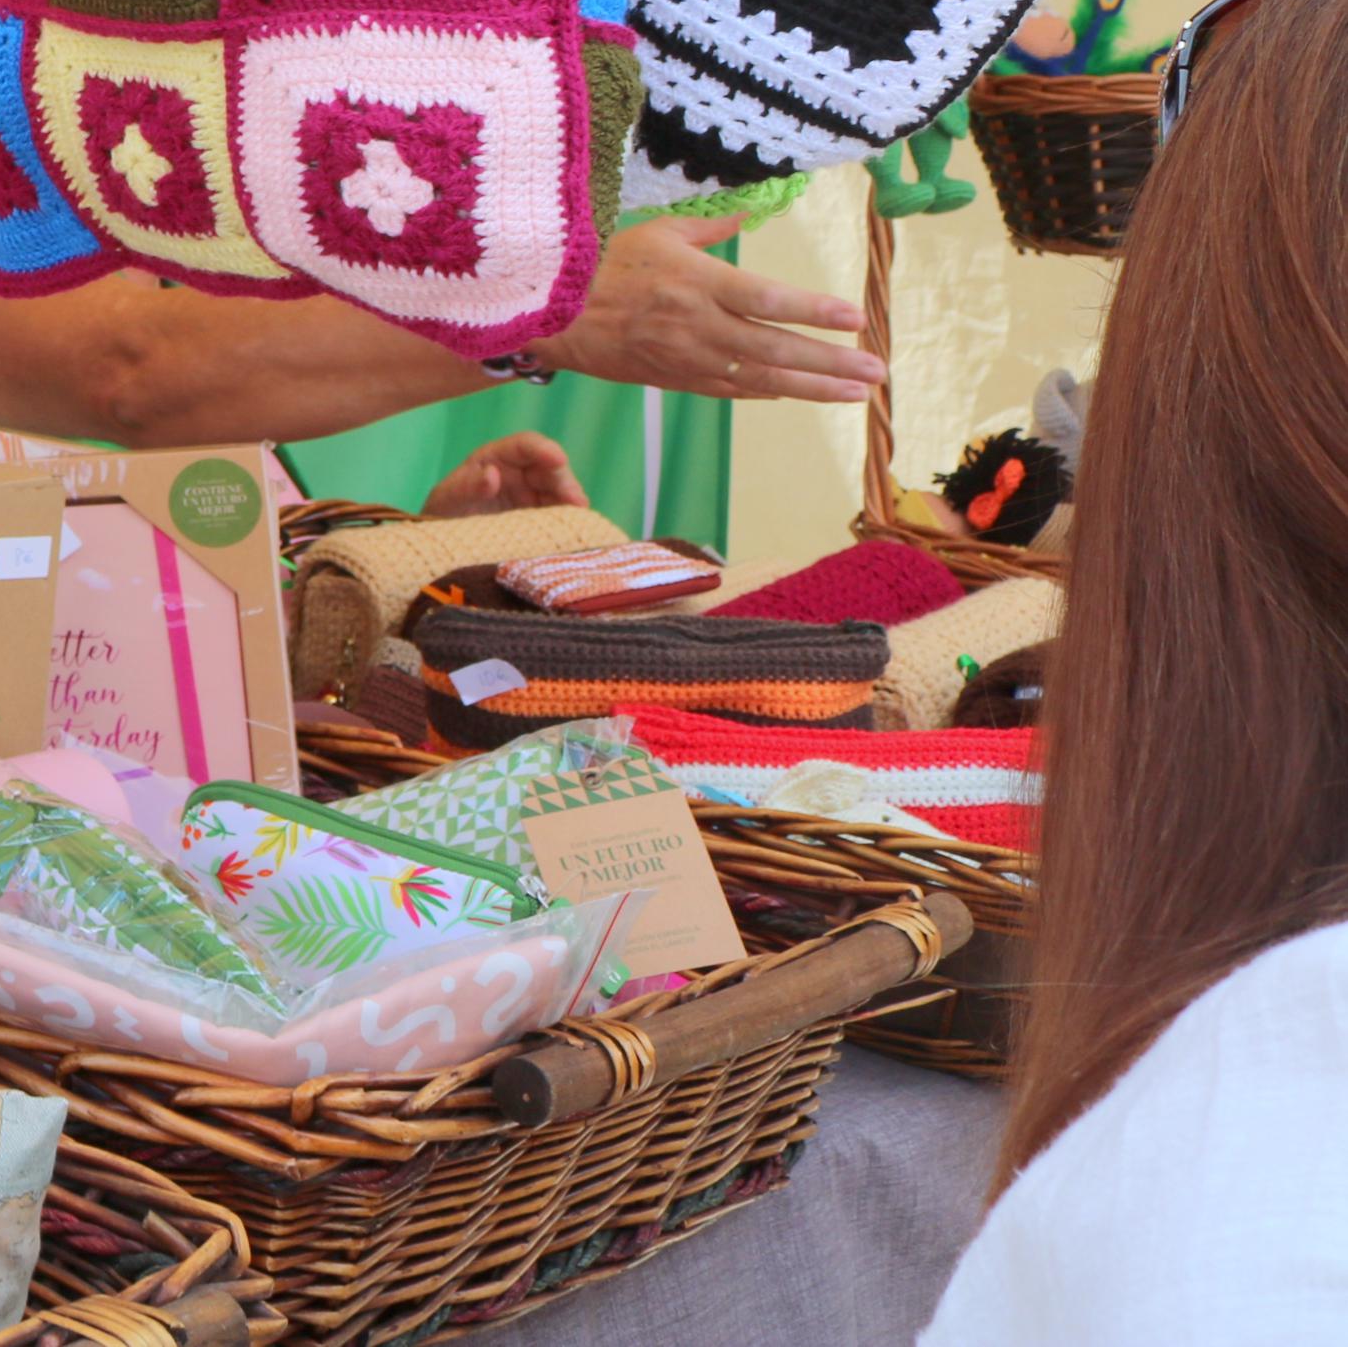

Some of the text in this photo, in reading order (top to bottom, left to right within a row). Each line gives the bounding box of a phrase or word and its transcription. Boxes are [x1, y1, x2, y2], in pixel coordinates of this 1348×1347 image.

[50, 629, 120, 667] etter
[49, 671, 123, 715] than
[558, 852, 590, 871] UN
[593, 834, 684, 864] FUTURO
[591, 856, 666, 883] MEJOR
